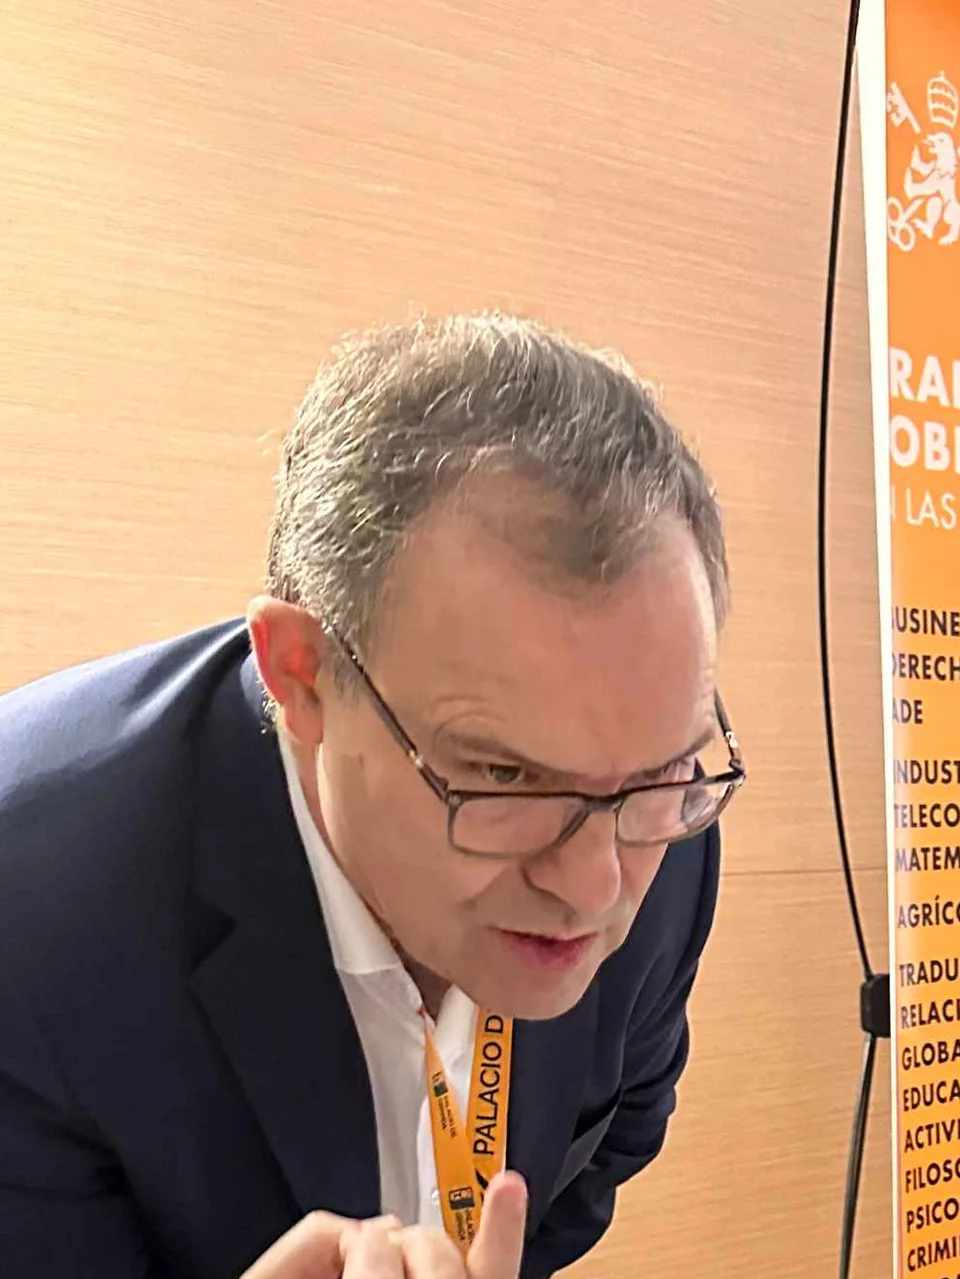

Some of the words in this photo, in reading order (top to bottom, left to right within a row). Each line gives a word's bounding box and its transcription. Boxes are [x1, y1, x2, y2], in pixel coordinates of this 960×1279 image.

[905, 487, 957, 531] LAS
[484, 1015, 504, 1034] D
[473, 1041, 502, 1156] PALACIO
